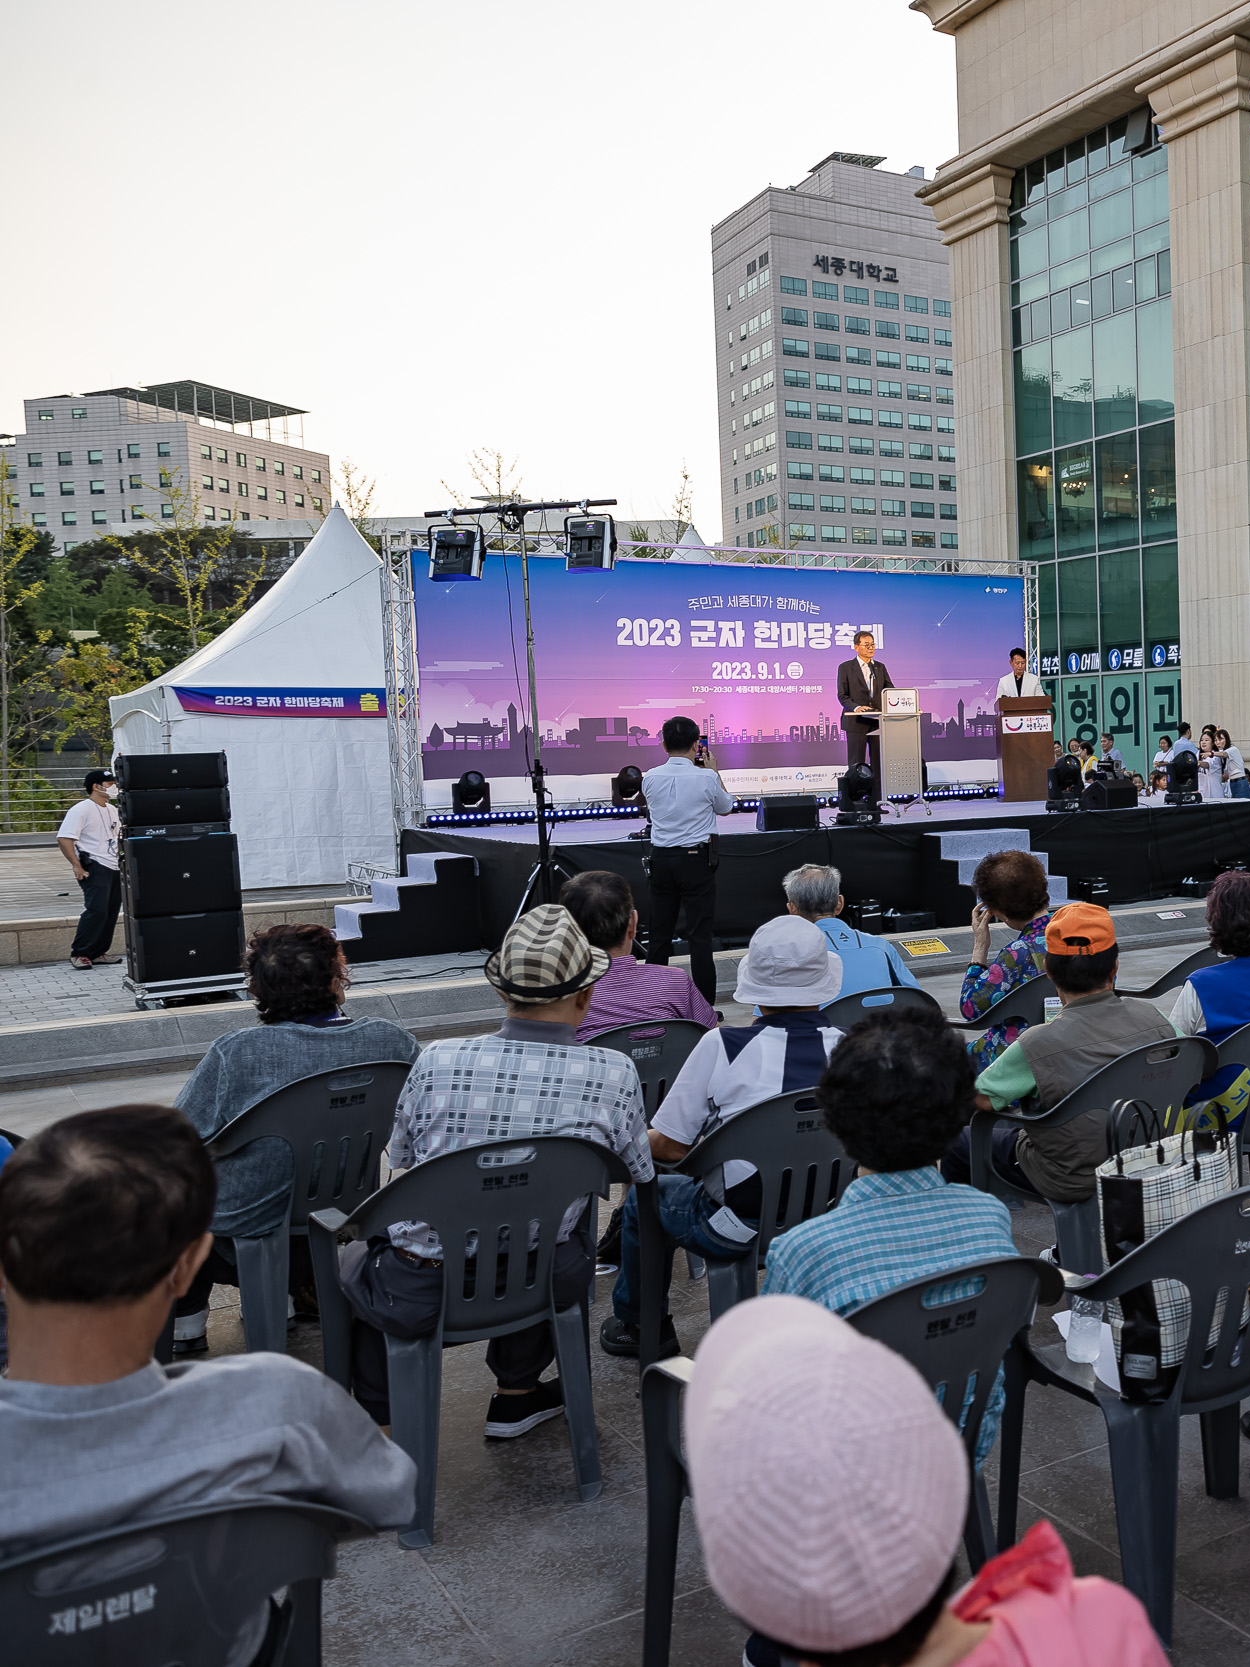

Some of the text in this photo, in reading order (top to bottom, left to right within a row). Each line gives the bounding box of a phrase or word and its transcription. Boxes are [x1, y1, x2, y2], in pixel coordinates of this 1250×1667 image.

[812, 254, 899, 283] 세종대학교
[688, 594, 821, 615] 주민과 세종대가 함께하는
[616, 617, 681, 647] 2023
[690, 620, 745, 648] 군자
[1122, 648, 1144, 668] 무릎
[1167, 645, 1181, 664] 족
[215, 695, 253, 707] 2023
[256, 696, 281, 708] 군자
[284, 696, 345, 708] 한마당축제
[48, 1584, 157, 1635] 제일렌탈
